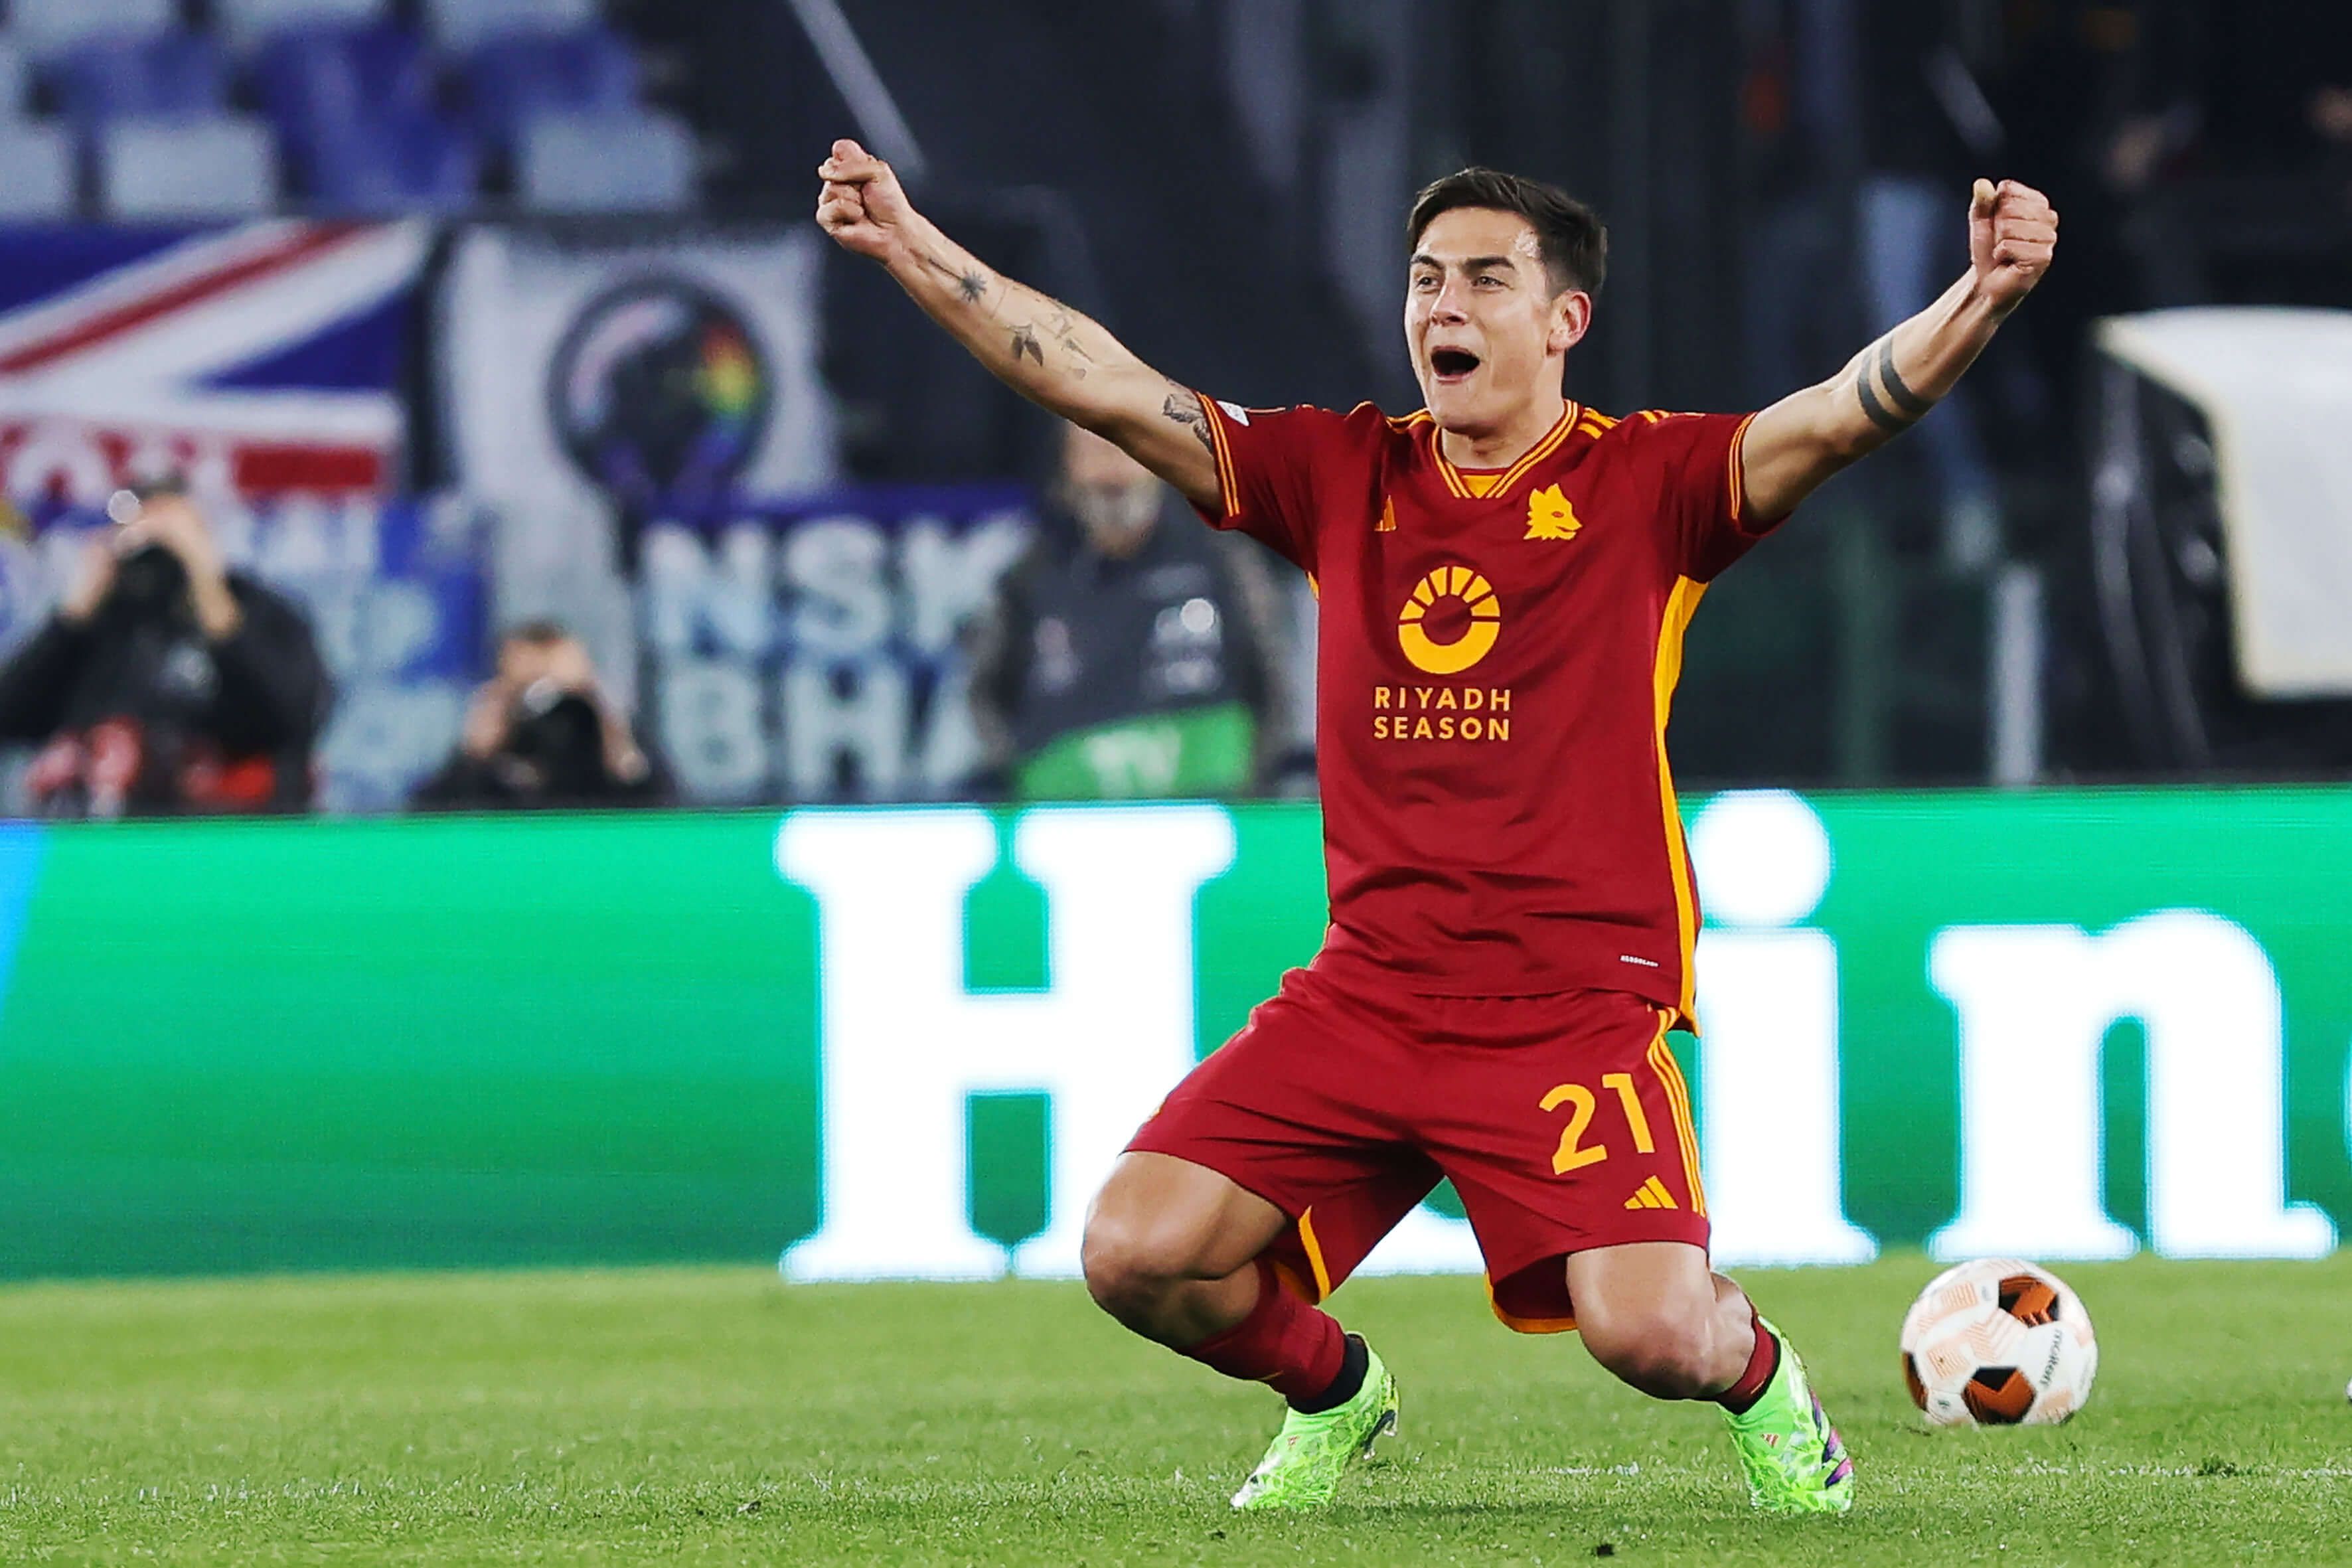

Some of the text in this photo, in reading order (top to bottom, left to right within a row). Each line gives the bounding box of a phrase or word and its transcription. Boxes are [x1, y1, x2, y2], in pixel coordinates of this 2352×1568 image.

[1374, 686, 1511, 712] RIYADH
[1373, 716, 1510, 741] SEASON
[1538, 1072, 1655, 1175] 21
[2039, 1328, 2063, 1387] molten
